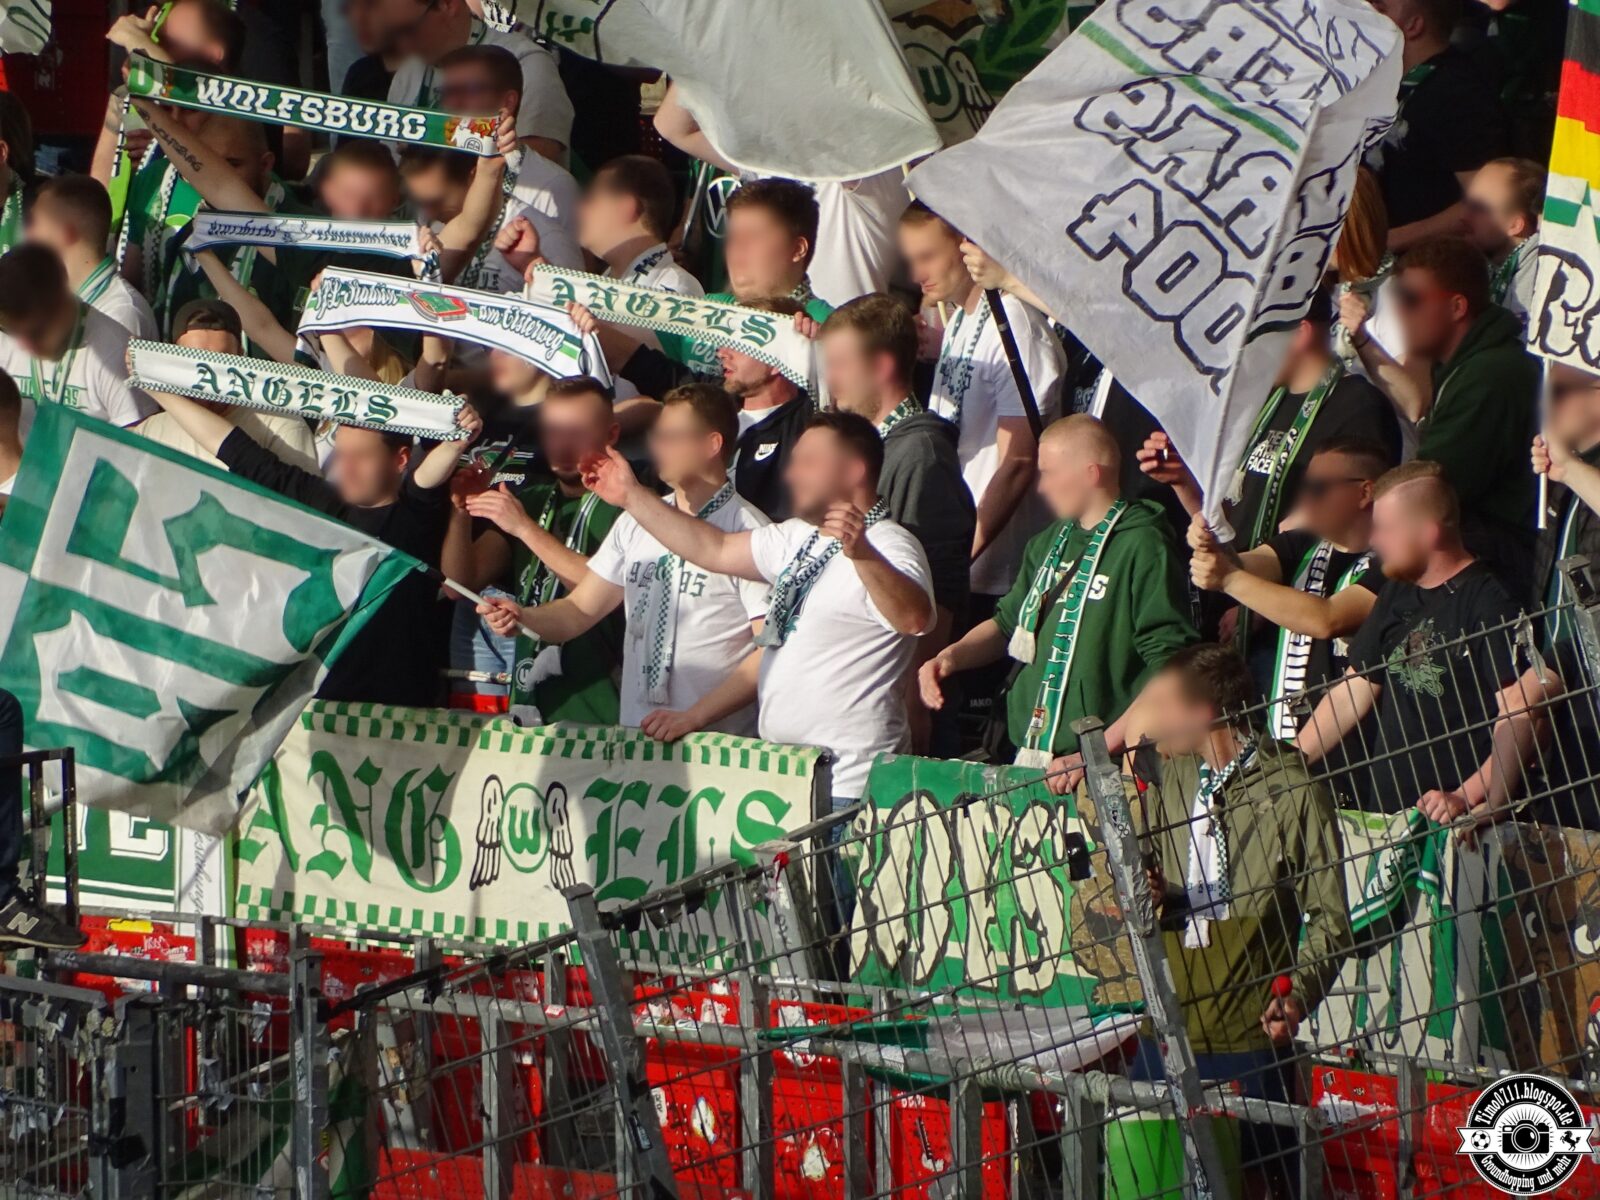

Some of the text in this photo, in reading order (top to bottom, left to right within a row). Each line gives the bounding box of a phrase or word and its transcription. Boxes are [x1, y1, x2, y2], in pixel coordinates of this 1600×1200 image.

[195, 75, 427, 141] WOLFSBURG
[478, 304, 501, 324] am
[501, 305, 566, 361] Elsterweg
[551, 277, 778, 348] ANGELS
[190, 362, 400, 425] ANGELS
